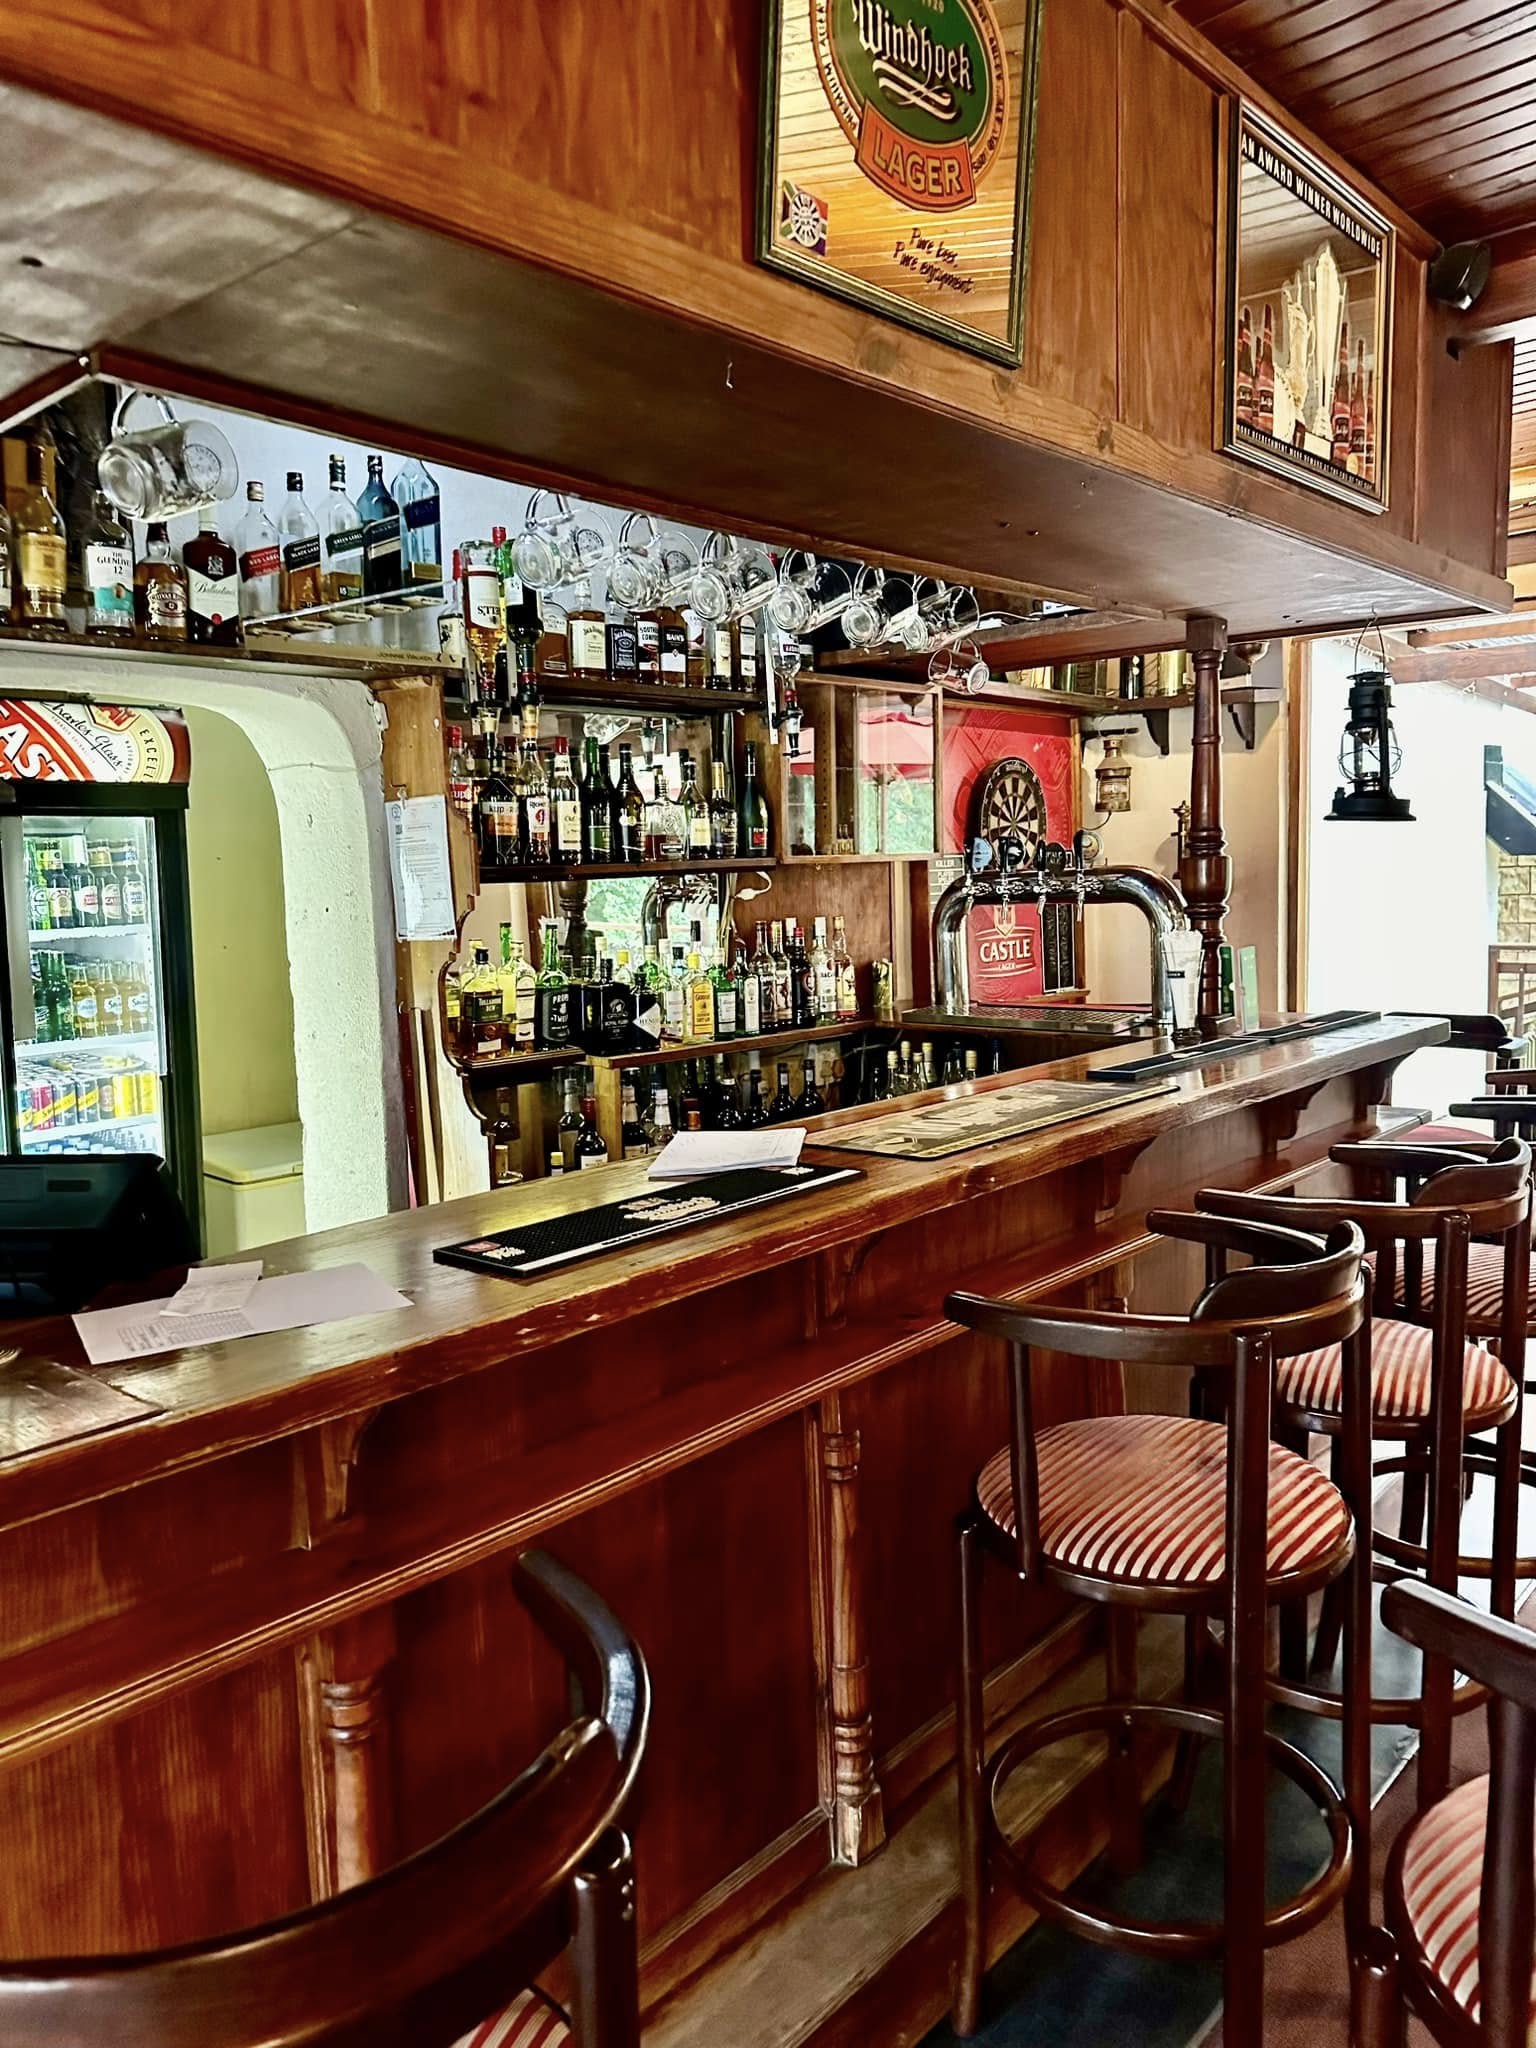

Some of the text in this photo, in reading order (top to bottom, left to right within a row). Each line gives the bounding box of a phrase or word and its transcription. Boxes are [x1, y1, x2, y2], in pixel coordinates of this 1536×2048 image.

[872, 127, 963, 196] LAGER
[1241, 133, 1381, 258] AN AWARD WINNER WORLDWIDE
[113, 566, 123, 575] 12
[980, 938, 1032, 963] CASTLE
